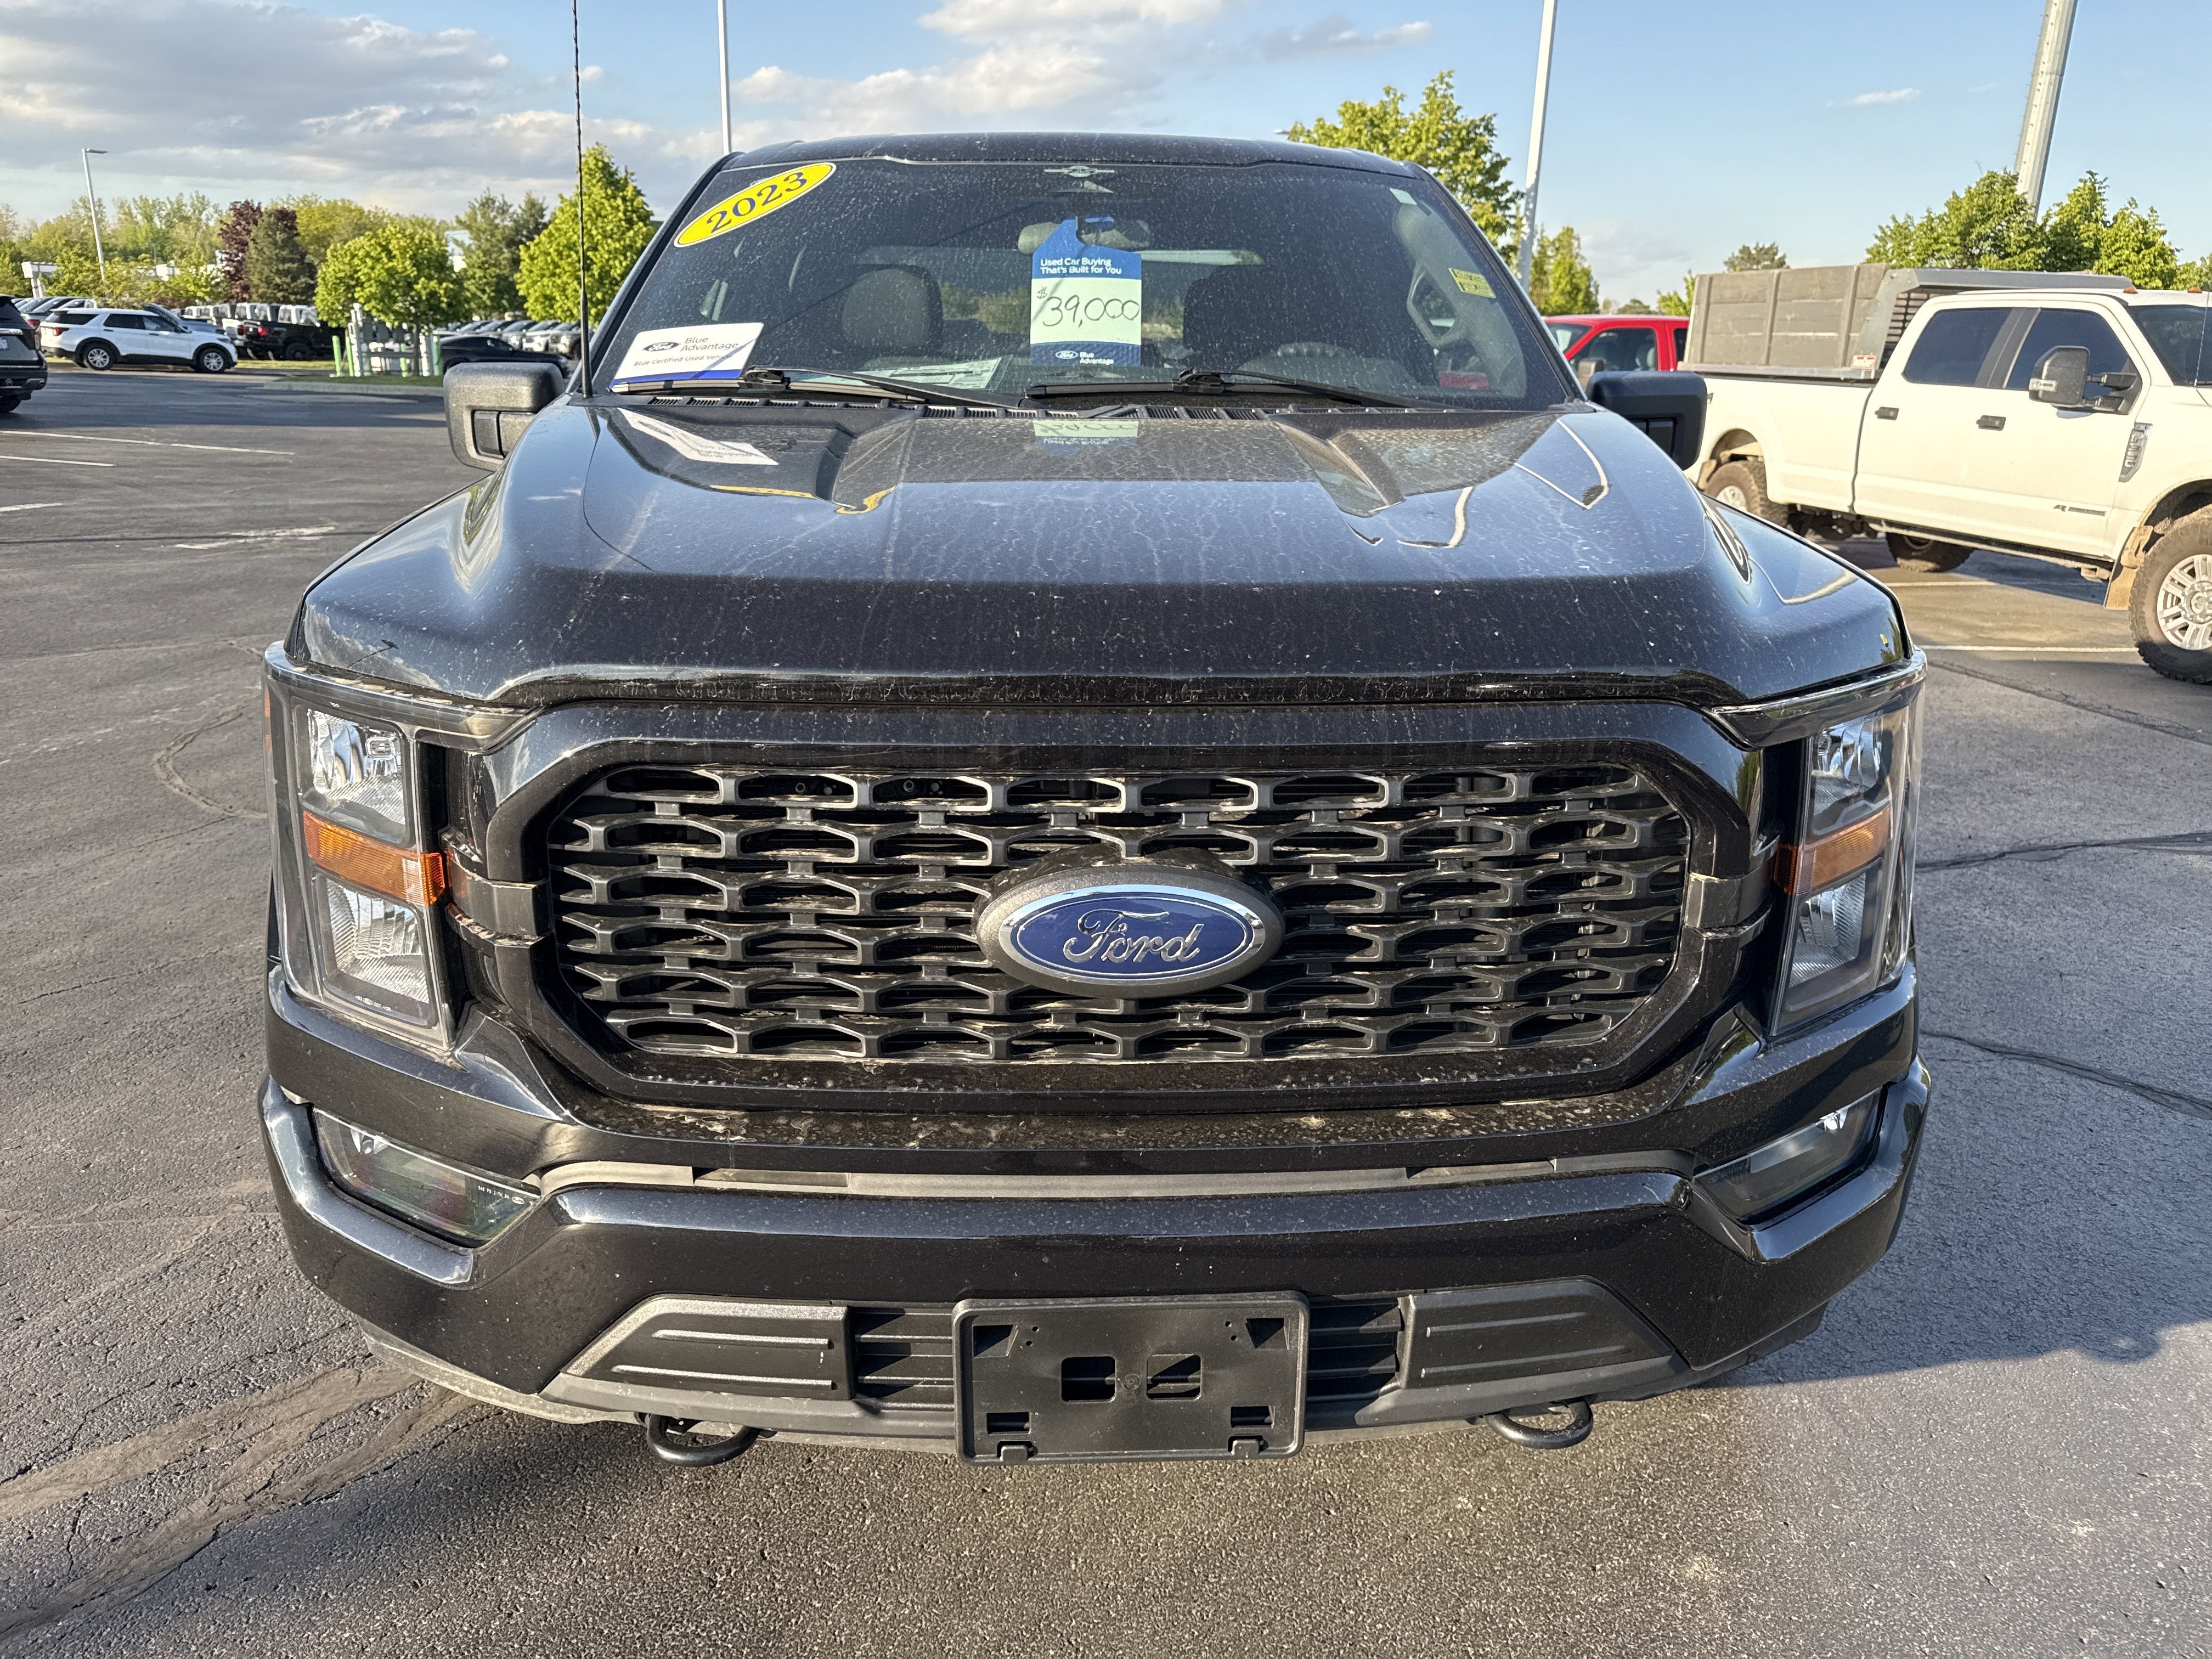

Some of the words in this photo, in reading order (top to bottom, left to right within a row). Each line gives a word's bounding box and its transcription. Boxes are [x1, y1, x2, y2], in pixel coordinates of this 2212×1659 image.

[707, 172, 807, 233] 2023
[1040, 258, 1063, 266] Used
[1082, 257, 1111, 267] Buying
[1040, 266, 1068, 274] That's
[647, 342, 675, 351] Ford
[680, 342, 738, 352] Advantage
[1063, 909, 1204, 963] Ford
